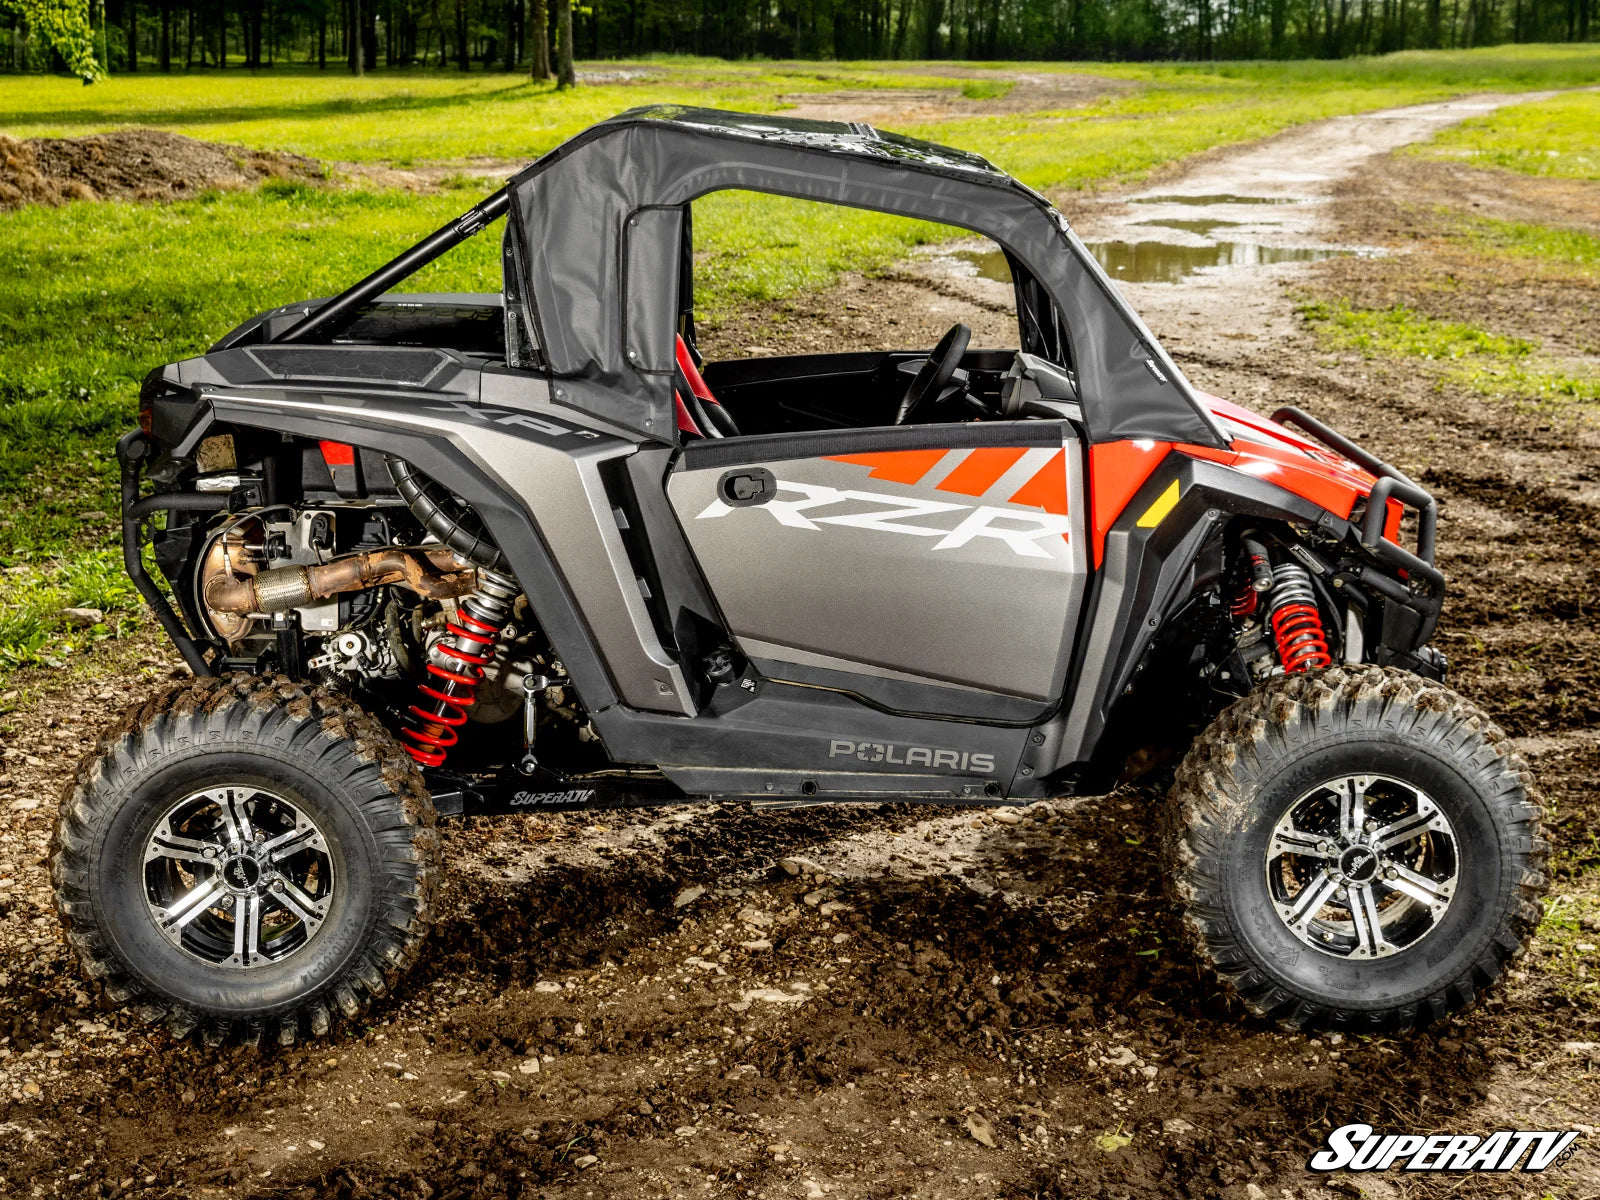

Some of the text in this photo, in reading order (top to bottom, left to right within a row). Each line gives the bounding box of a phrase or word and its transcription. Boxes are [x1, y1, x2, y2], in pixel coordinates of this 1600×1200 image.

[422, 402, 573, 436] XP
[694, 479, 1069, 559] RZR
[829, 739, 995, 773] POLARIS
[509, 789, 595, 805] SUPERATV
